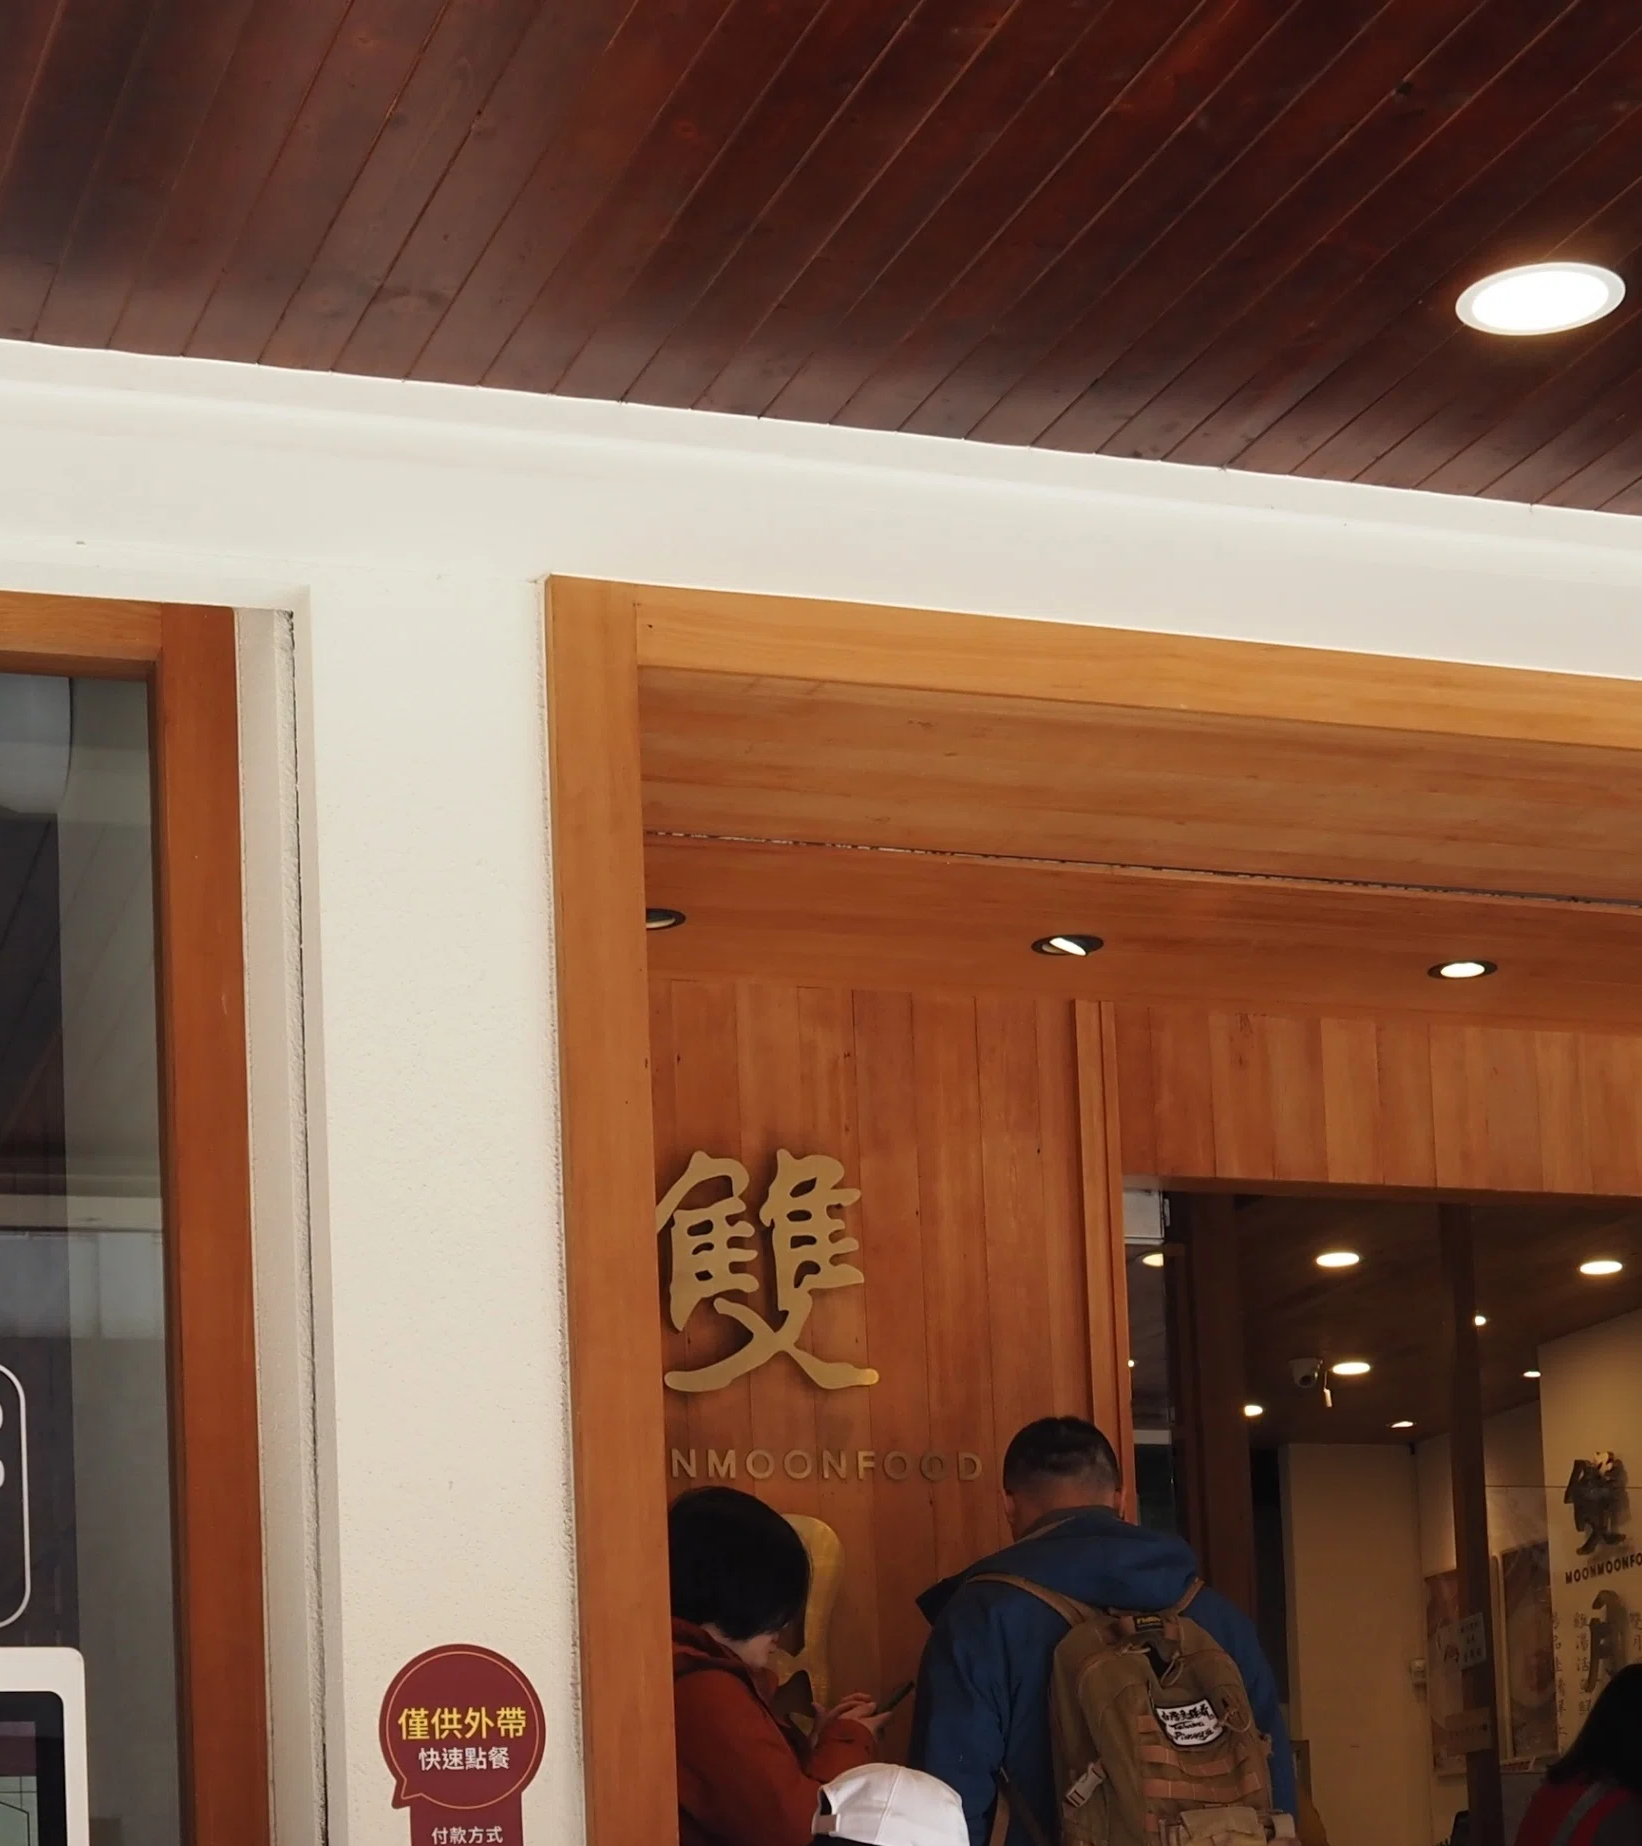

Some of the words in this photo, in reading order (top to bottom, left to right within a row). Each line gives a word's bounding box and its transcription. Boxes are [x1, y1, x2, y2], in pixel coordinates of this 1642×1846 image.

[656, 1148, 879, 1392] 雙
[398, 1707, 526, 1740] 僅供外帶
[418, 1747, 510, 1771] 快速點餐
[431, 1826, 503, 1845] 付款方式
